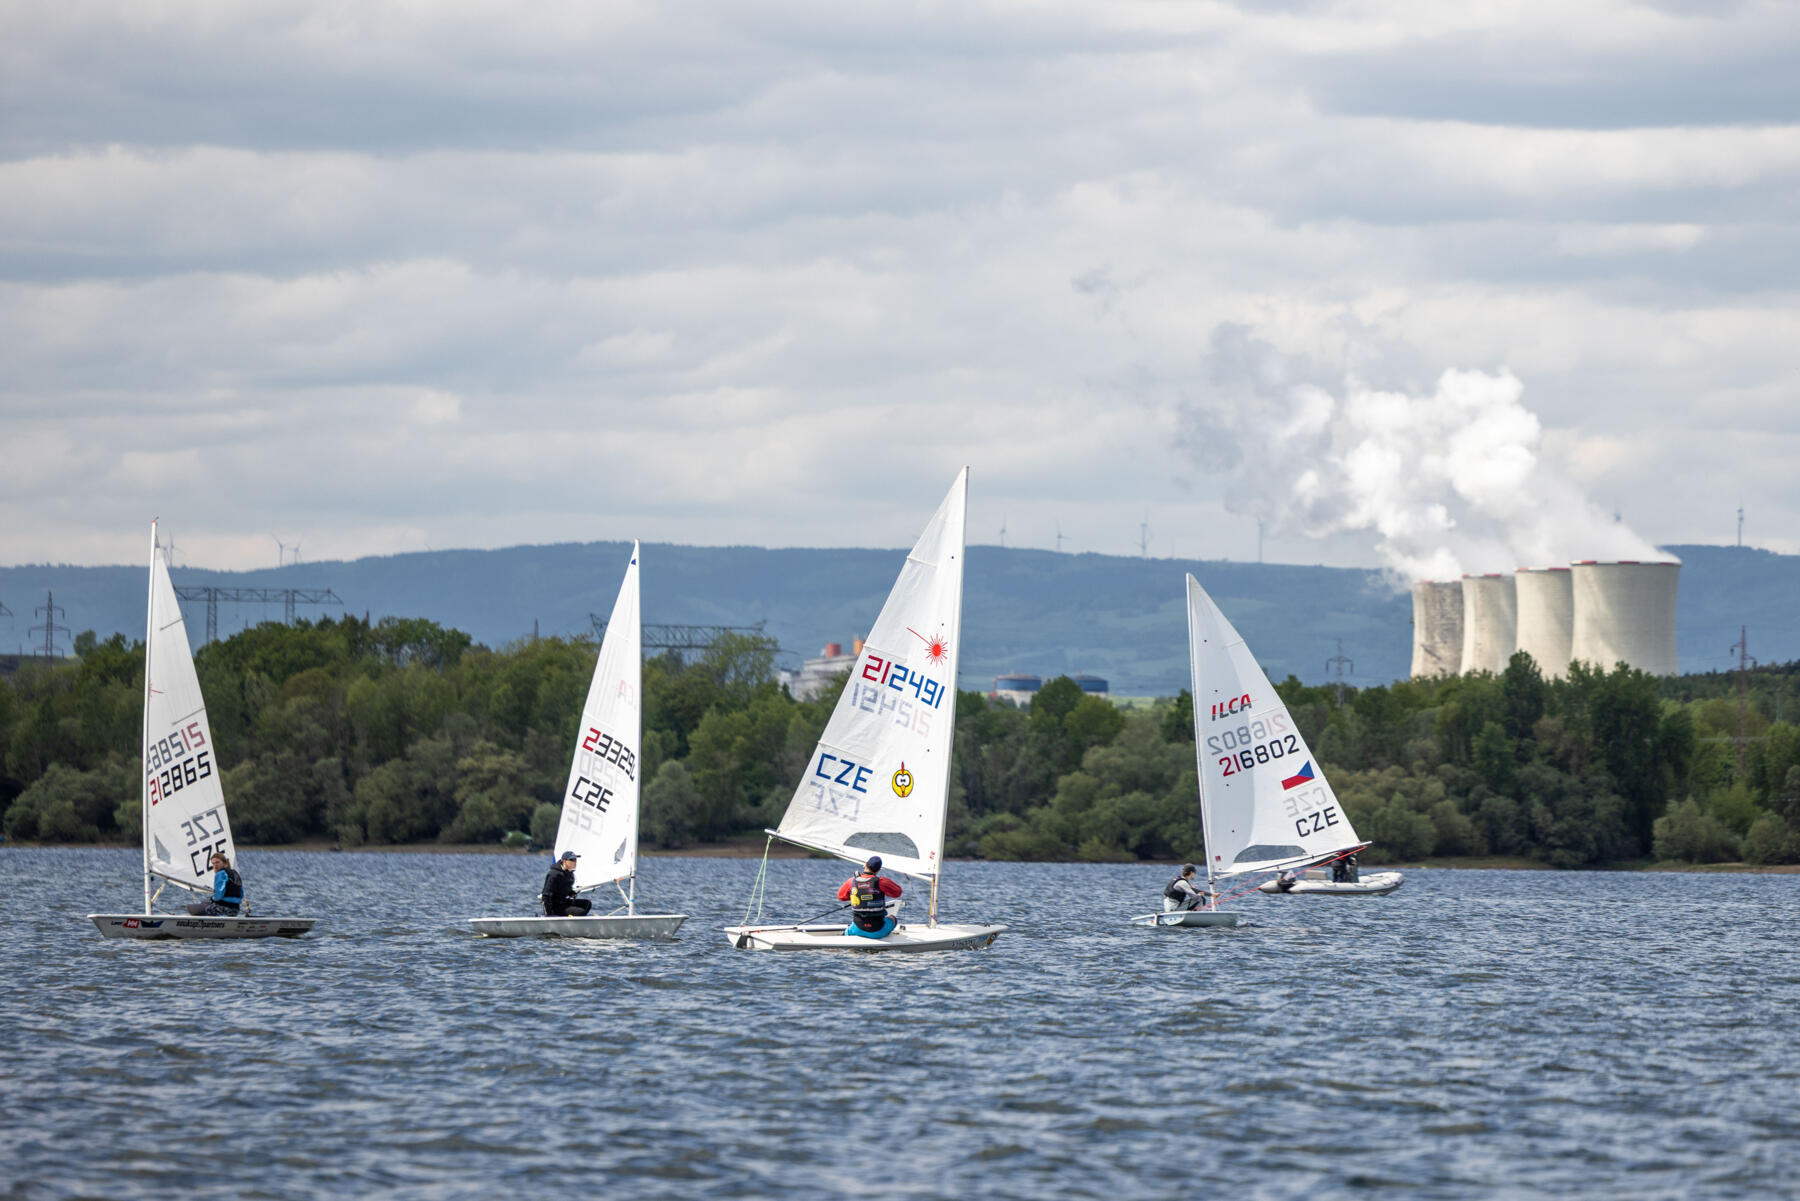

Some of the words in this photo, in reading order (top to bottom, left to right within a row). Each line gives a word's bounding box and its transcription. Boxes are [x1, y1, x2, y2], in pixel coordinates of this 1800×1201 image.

[862, 655, 945, 709] 212491
[1211, 694, 1252, 721] ILCA
[815, 753, 873, 793] CZE
[1218, 734, 1300, 778] 216802
[150, 751, 211, 806] 212865
[1295, 806, 1339, 837] CZE
